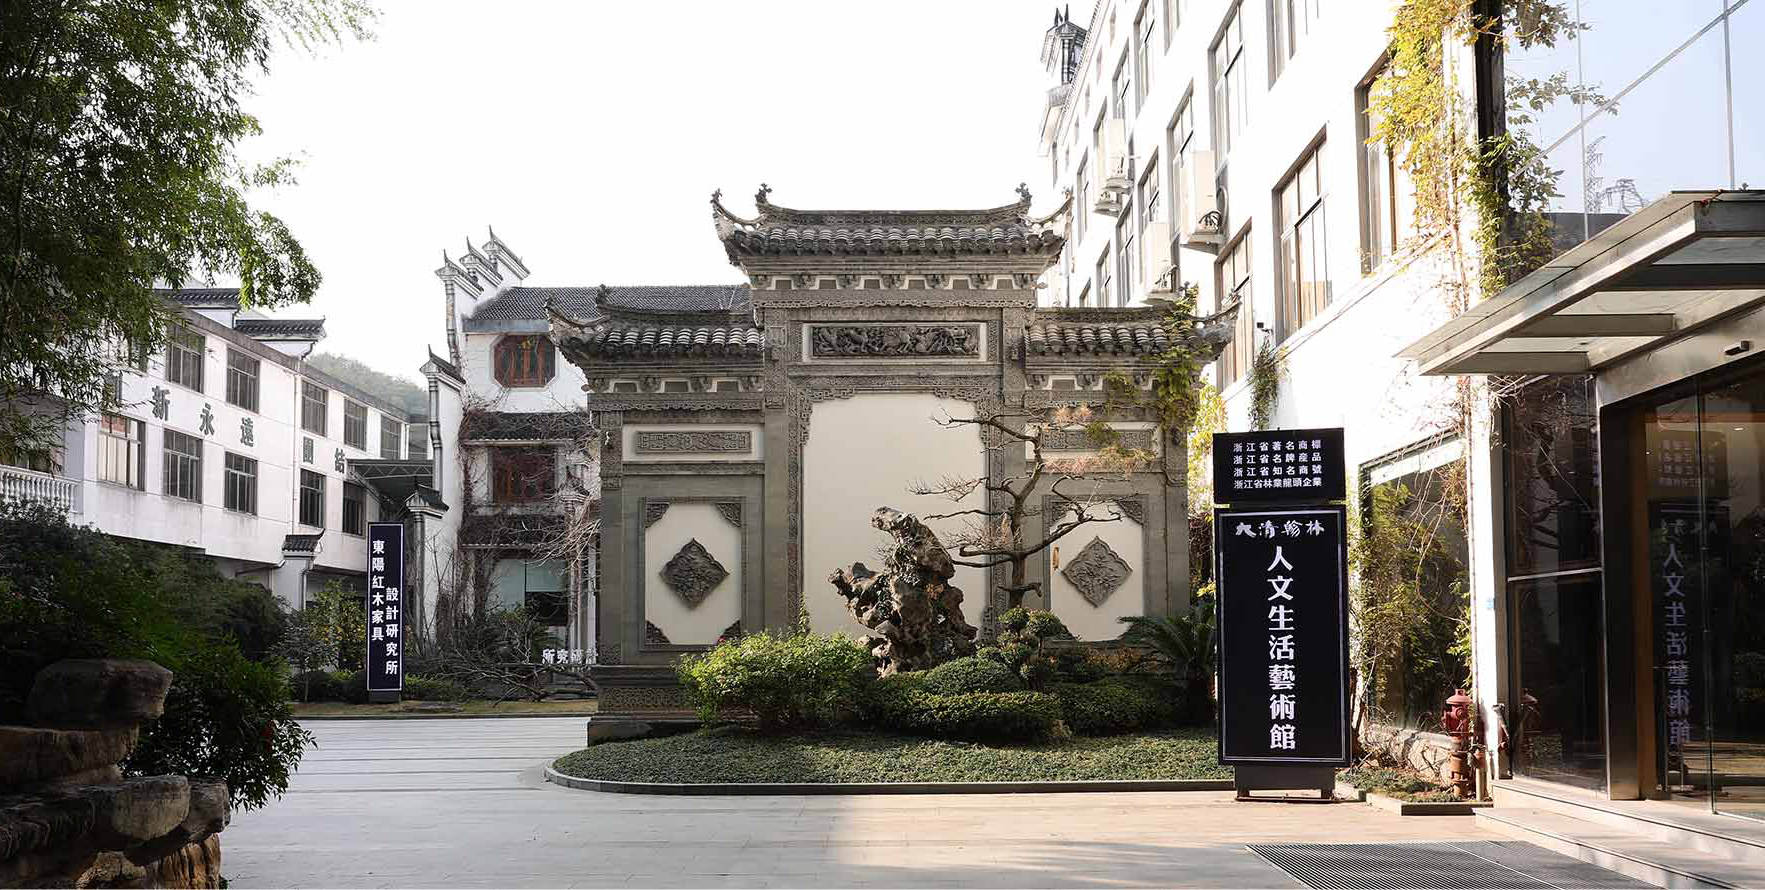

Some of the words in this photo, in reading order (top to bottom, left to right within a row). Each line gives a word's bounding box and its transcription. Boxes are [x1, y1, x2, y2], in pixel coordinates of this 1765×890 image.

[1233, 439, 1322, 453] 浙江省著名商標
[1233, 464, 1323, 478] 浙江省知名商號
[1233, 477, 1323, 490] 浙江省林業龍頭企業
[371, 539, 386, 642] 東陽紅木家具
[385, 586, 399, 675] 設計研究所
[1267, 545, 1296, 750] 人文生活藝術館
